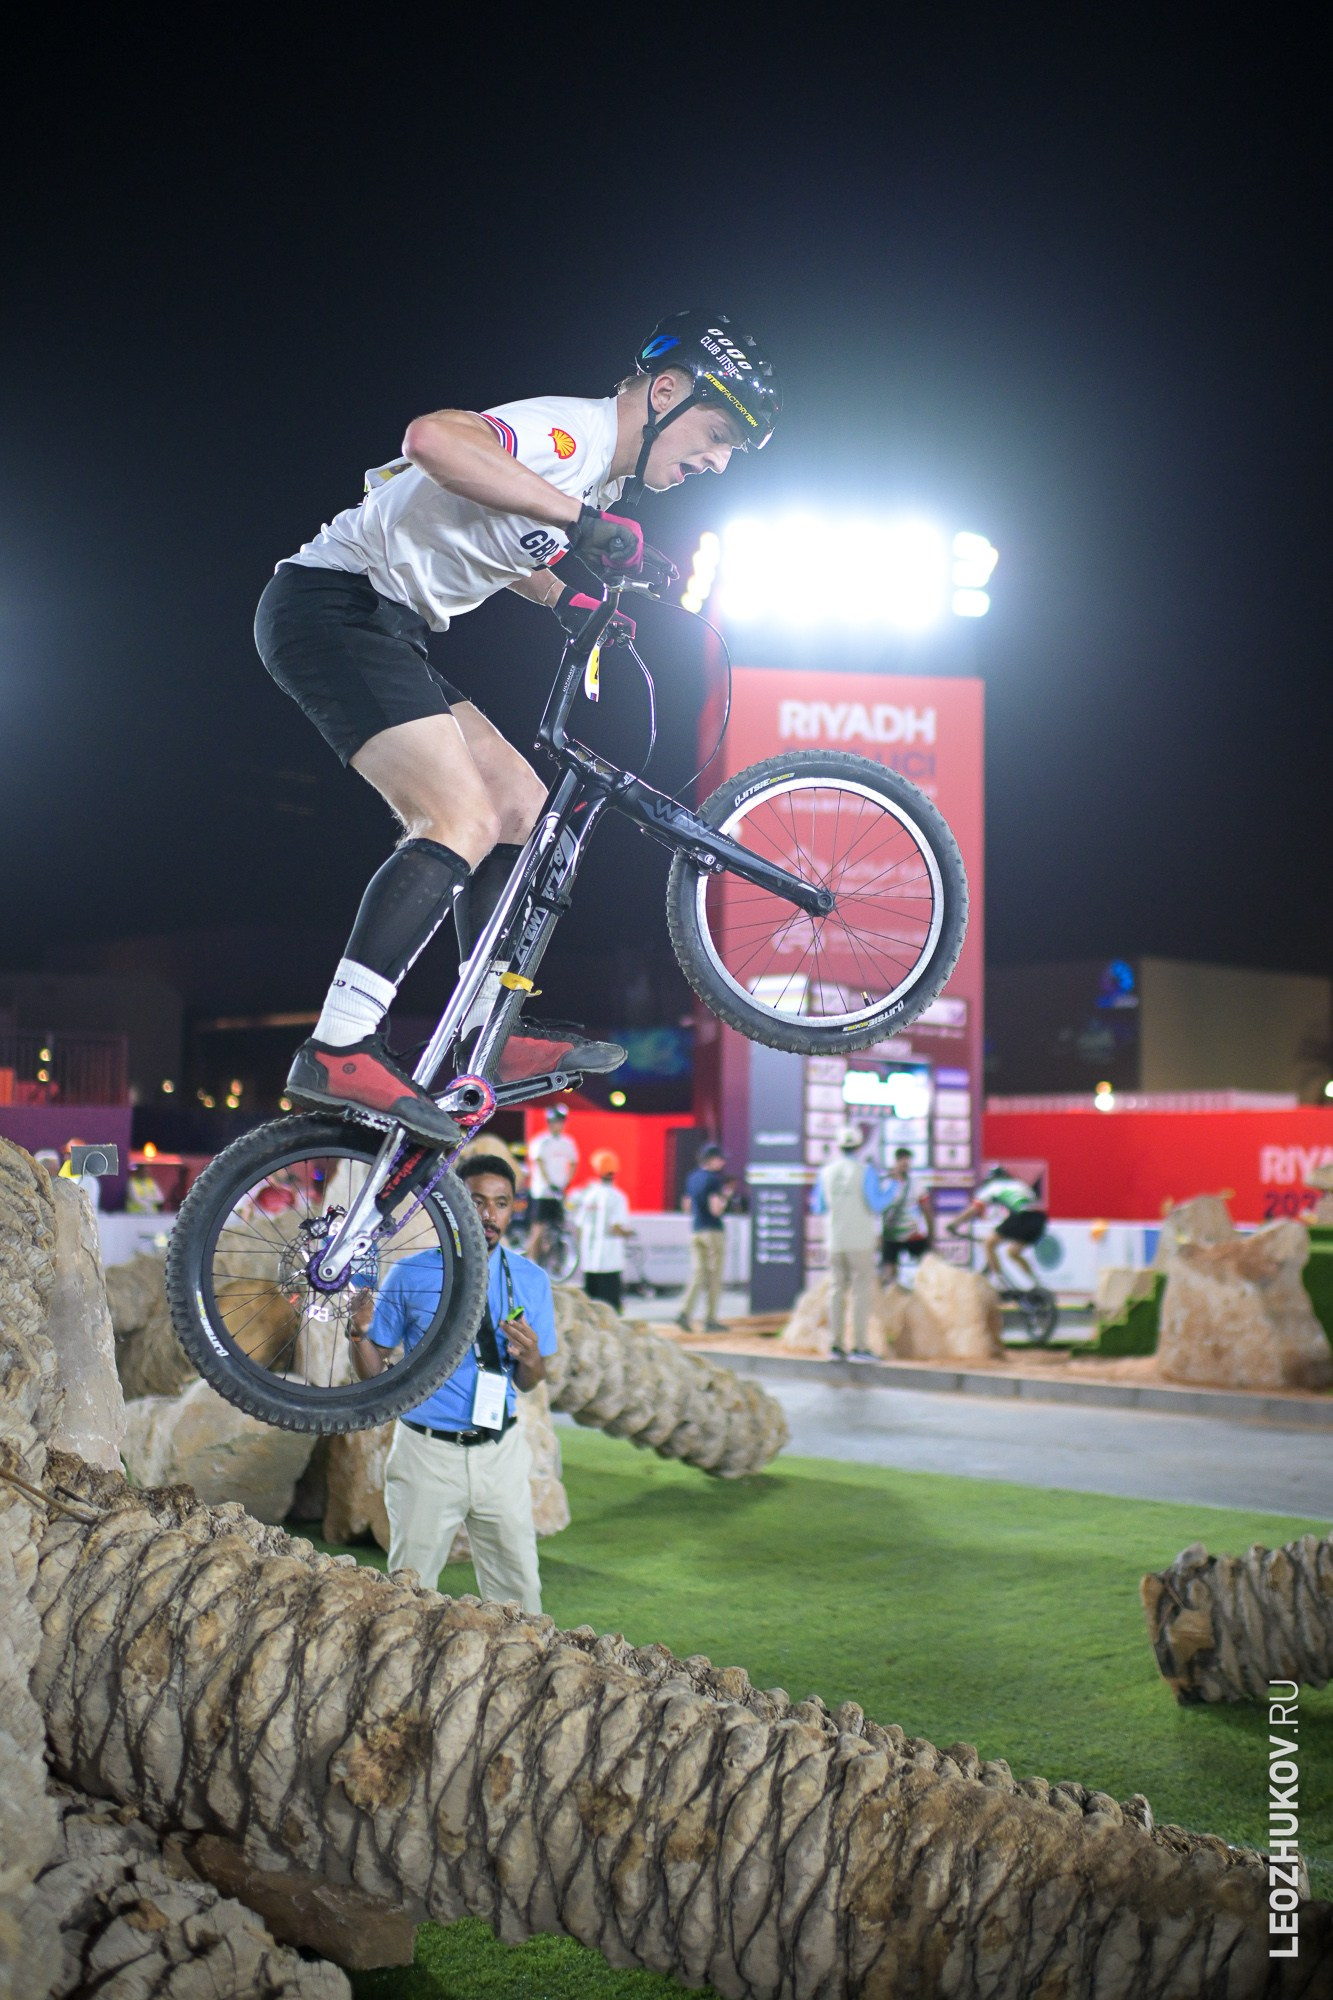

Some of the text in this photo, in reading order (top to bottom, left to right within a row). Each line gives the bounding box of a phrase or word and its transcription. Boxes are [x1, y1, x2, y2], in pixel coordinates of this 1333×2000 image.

[700, 335, 740, 378] CLUB JITSIE
[780, 701, 935, 743] RIYADH
[524, 850, 539, 879] ULTIMATE
